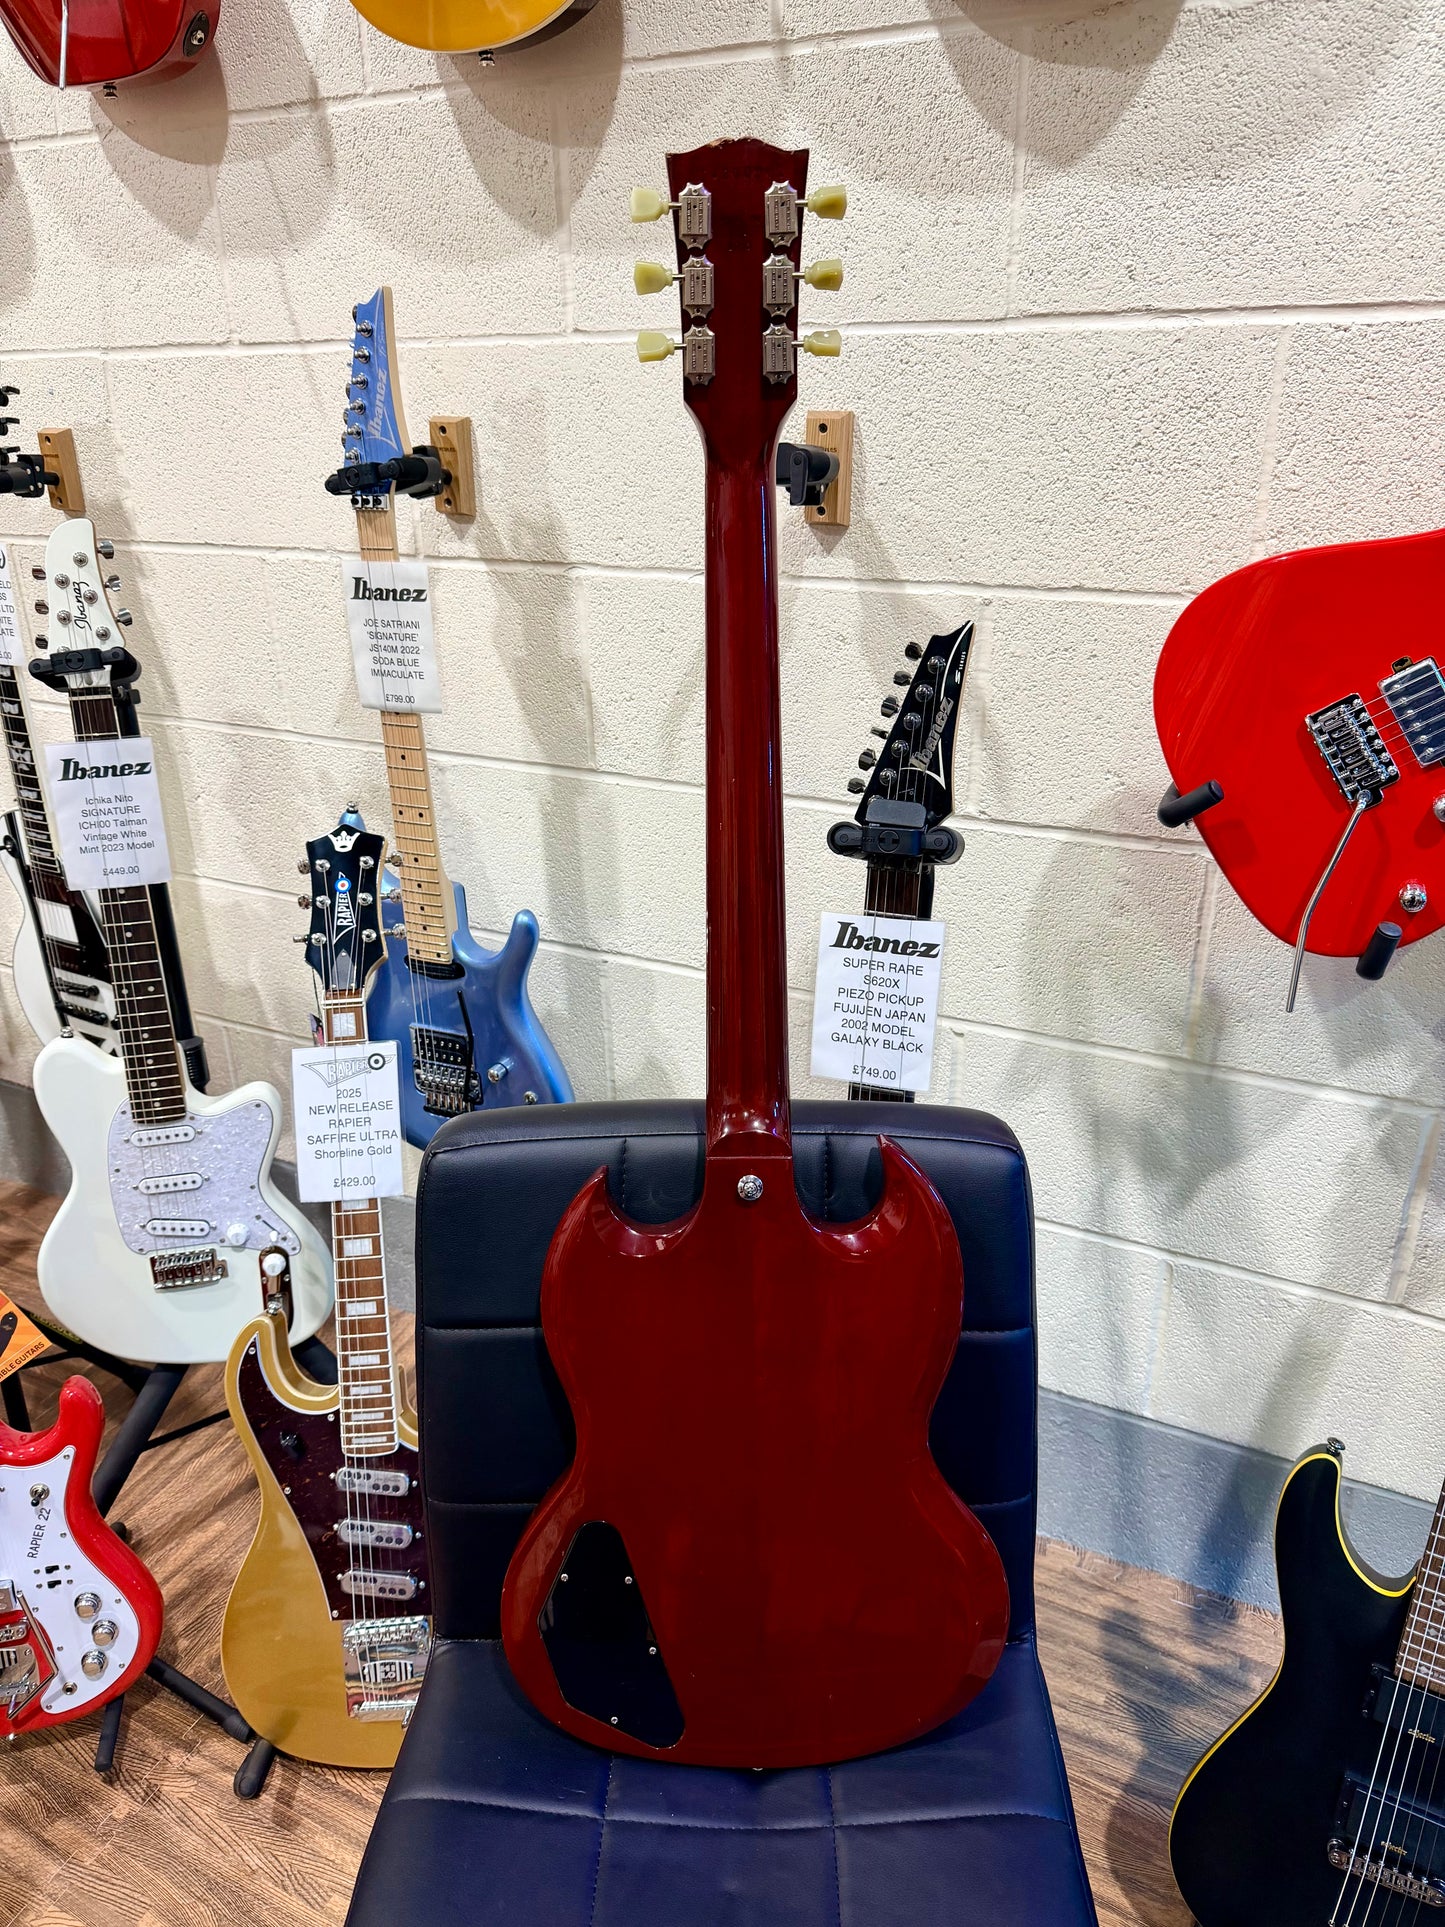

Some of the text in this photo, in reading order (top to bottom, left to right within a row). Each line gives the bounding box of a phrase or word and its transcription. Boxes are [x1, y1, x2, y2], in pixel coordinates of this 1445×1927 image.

[368, 367, 387, 438] Ibanez
[351, 576, 427, 602] Ibanez
[1, 605, 15, 613] LTD
[72, 582, 92, 631] Ibanez
[363, 618, 420, 629] JOE SATRIANI
[369, 645, 421, 654] JS140M 2022
[373, 657, 419, 667] SODA BLUE
[371, 669, 425, 680] IMMACULATE
[386, 694, 415, 704] £799.00
[909, 697, 954, 774] Ibanez
[57, 758, 152, 781] Ibanez
[86, 795, 133, 805] Ichika Nito
[81, 805, 141, 818] SIGNATURE
[114, 818, 147, 827] Talman
[83, 830, 147, 841] Vintage White
[80, 841, 155, 854] Mint 2023 Model
[102, 866, 140, 876] £449.00
[337, 893, 352, 926] RAPIER
[829, 921, 941, 958] Ibanez
[843, 957, 923, 976] SUPER RARE
[863, 975, 900, 989] S620X
[838, 988, 924, 1006] PIEZO PICKUP
[834, 1002, 926, 1023] FUJIJEN JAPAN
[841, 1019, 915, 1037] 2002 MODEL
[831, 1032, 923, 1053] GALAXY BLACK
[328, 1061, 368, 1082] RAPIER
[852, 1065, 896, 1080] £749.00
[336, 1088, 362, 1099] 2025
[309, 1100, 393, 1115] NEW RELEASE
[328, 1117, 371, 1128] RAPIER
[307, 1130, 398, 1145] SAFFIRE ULTRA
[314, 1145, 392, 1159] Shoreline Gold
[333, 1176, 376, 1188] £429.00
[15, 1342, 44, 1364] GUITARS
[27, 1507, 51, 1558] RAPIER 22
